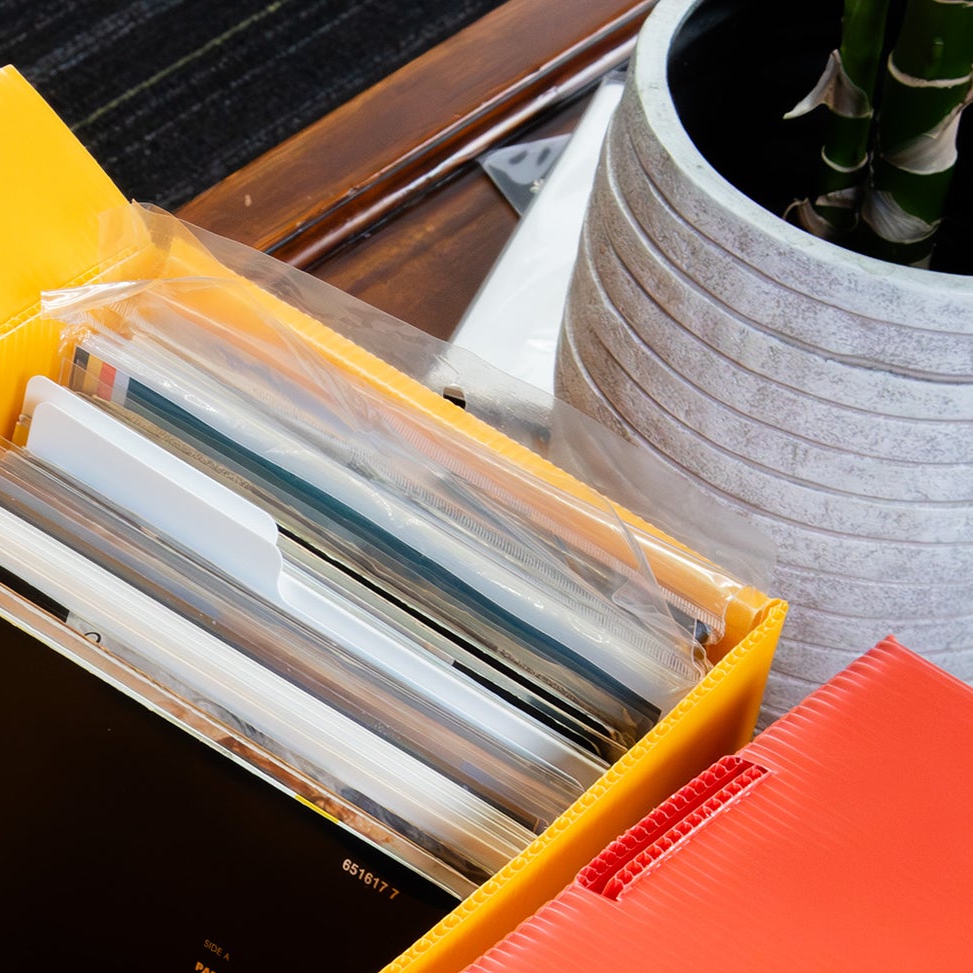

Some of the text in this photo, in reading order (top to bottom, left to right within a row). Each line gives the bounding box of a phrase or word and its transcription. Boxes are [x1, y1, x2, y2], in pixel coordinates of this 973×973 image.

[342, 858, 400, 900] 651617 7
[203, 939, 230, 961] SIDE A
